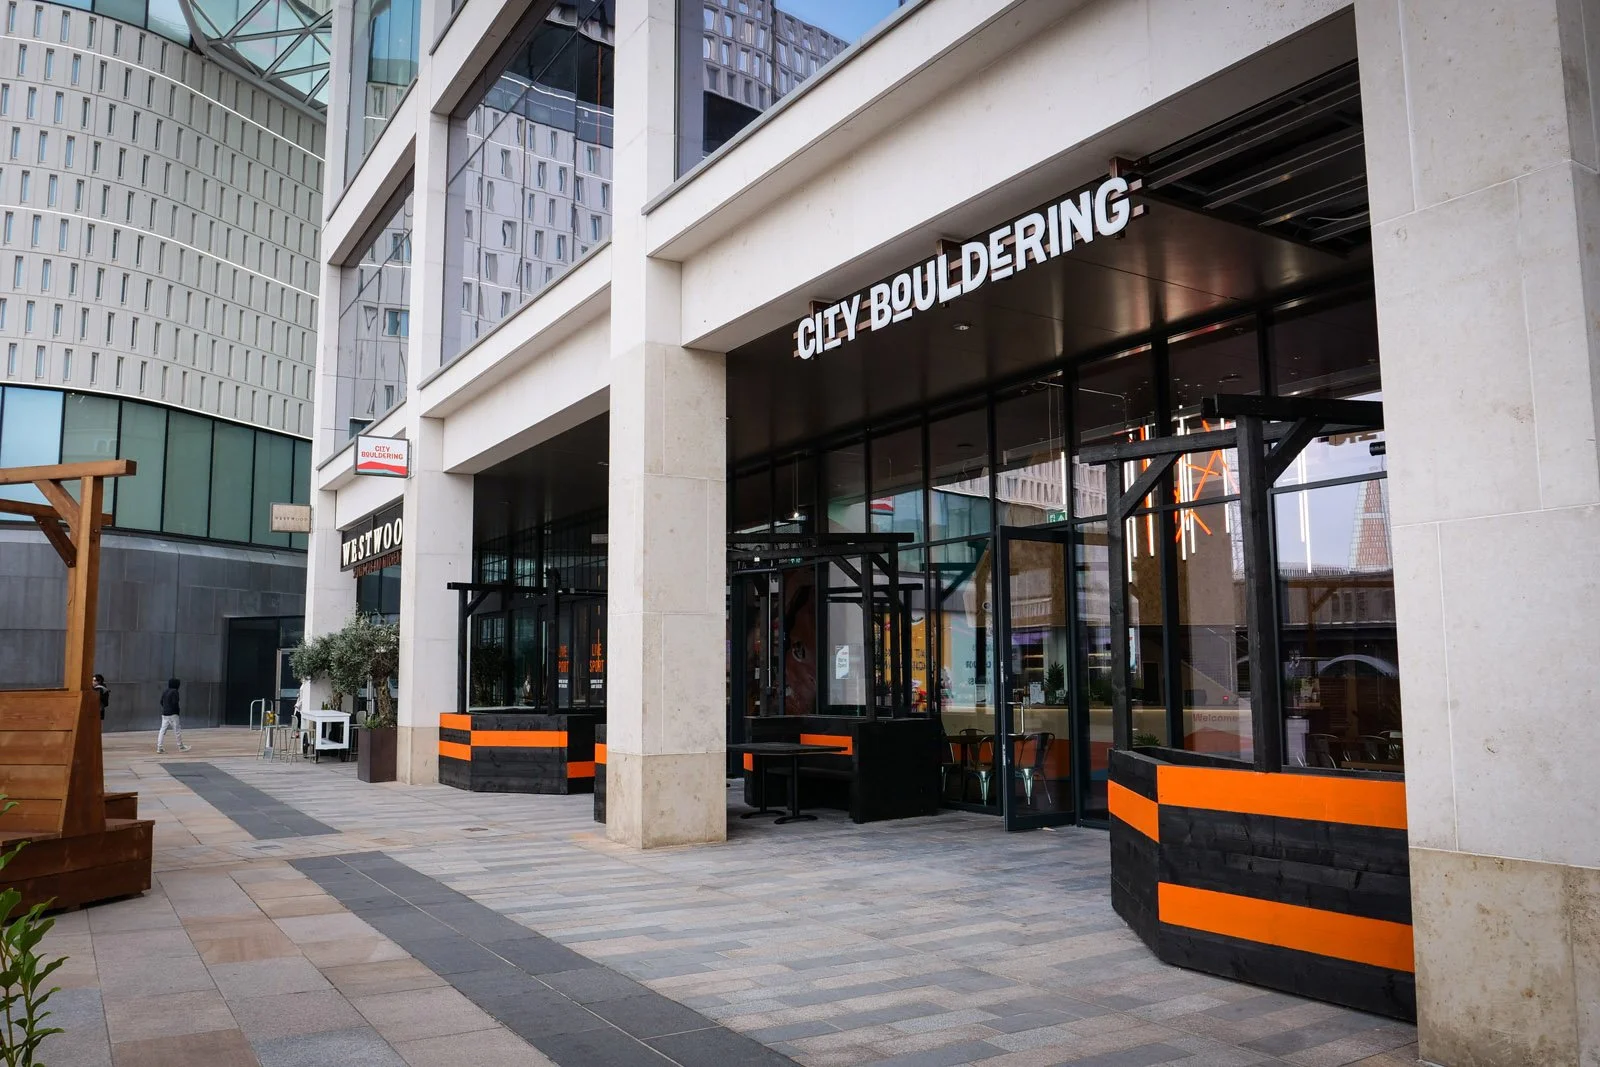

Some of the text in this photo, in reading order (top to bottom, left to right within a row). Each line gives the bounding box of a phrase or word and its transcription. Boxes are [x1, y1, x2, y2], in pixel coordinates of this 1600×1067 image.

[797, 176, 1132, 360] CITY BOULDERING
[374, 445, 391, 453] CITY
[361, 451, 404, 460] BOULDERING
[342, 518, 402, 567] WESTWOO
[1192, 713, 1239, 722] Welcome
